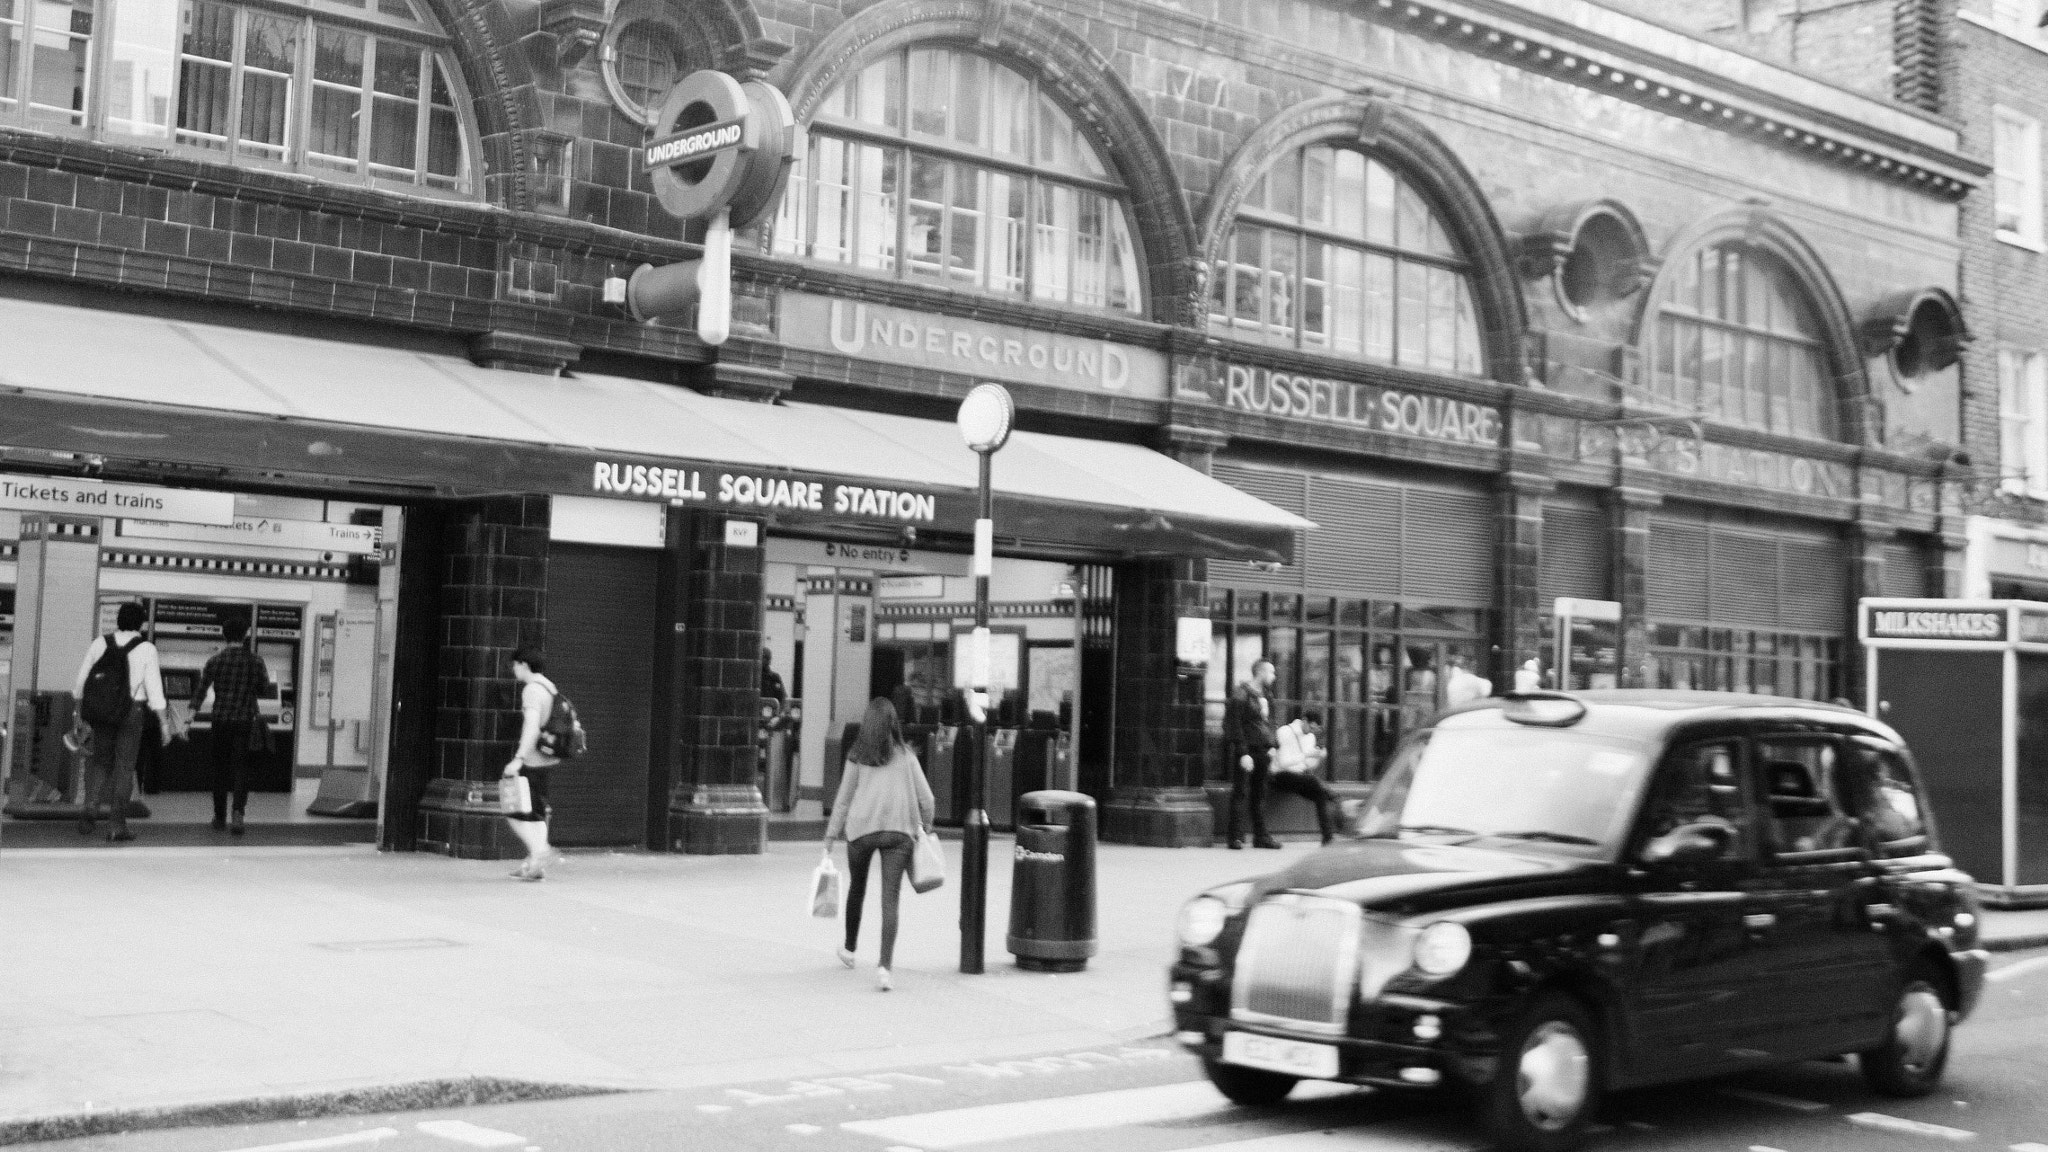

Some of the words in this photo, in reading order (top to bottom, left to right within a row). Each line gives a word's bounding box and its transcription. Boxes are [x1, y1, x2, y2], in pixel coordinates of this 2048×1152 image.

[647, 124, 742, 164] UNDERGROUND
[831, 299, 1130, 390] UNDERGROUND
[1226, 365, 1369, 426] RUSSELL
[1381, 390, 1499, 446] SQUARE
[3, 481, 70, 502] Tickets
[75, 489, 108, 505] and
[114, 492, 164, 510] trains
[594, 461, 706, 500] RUSSELL
[718, 474, 823, 510] SQUARE
[834, 485, 935, 521] STATION
[329, 526, 360, 540] Trains
[839, 543, 859, 559] No
[862, 548, 895, 563] entry
[1874, 611, 2000, 638] MILKSHAKES
